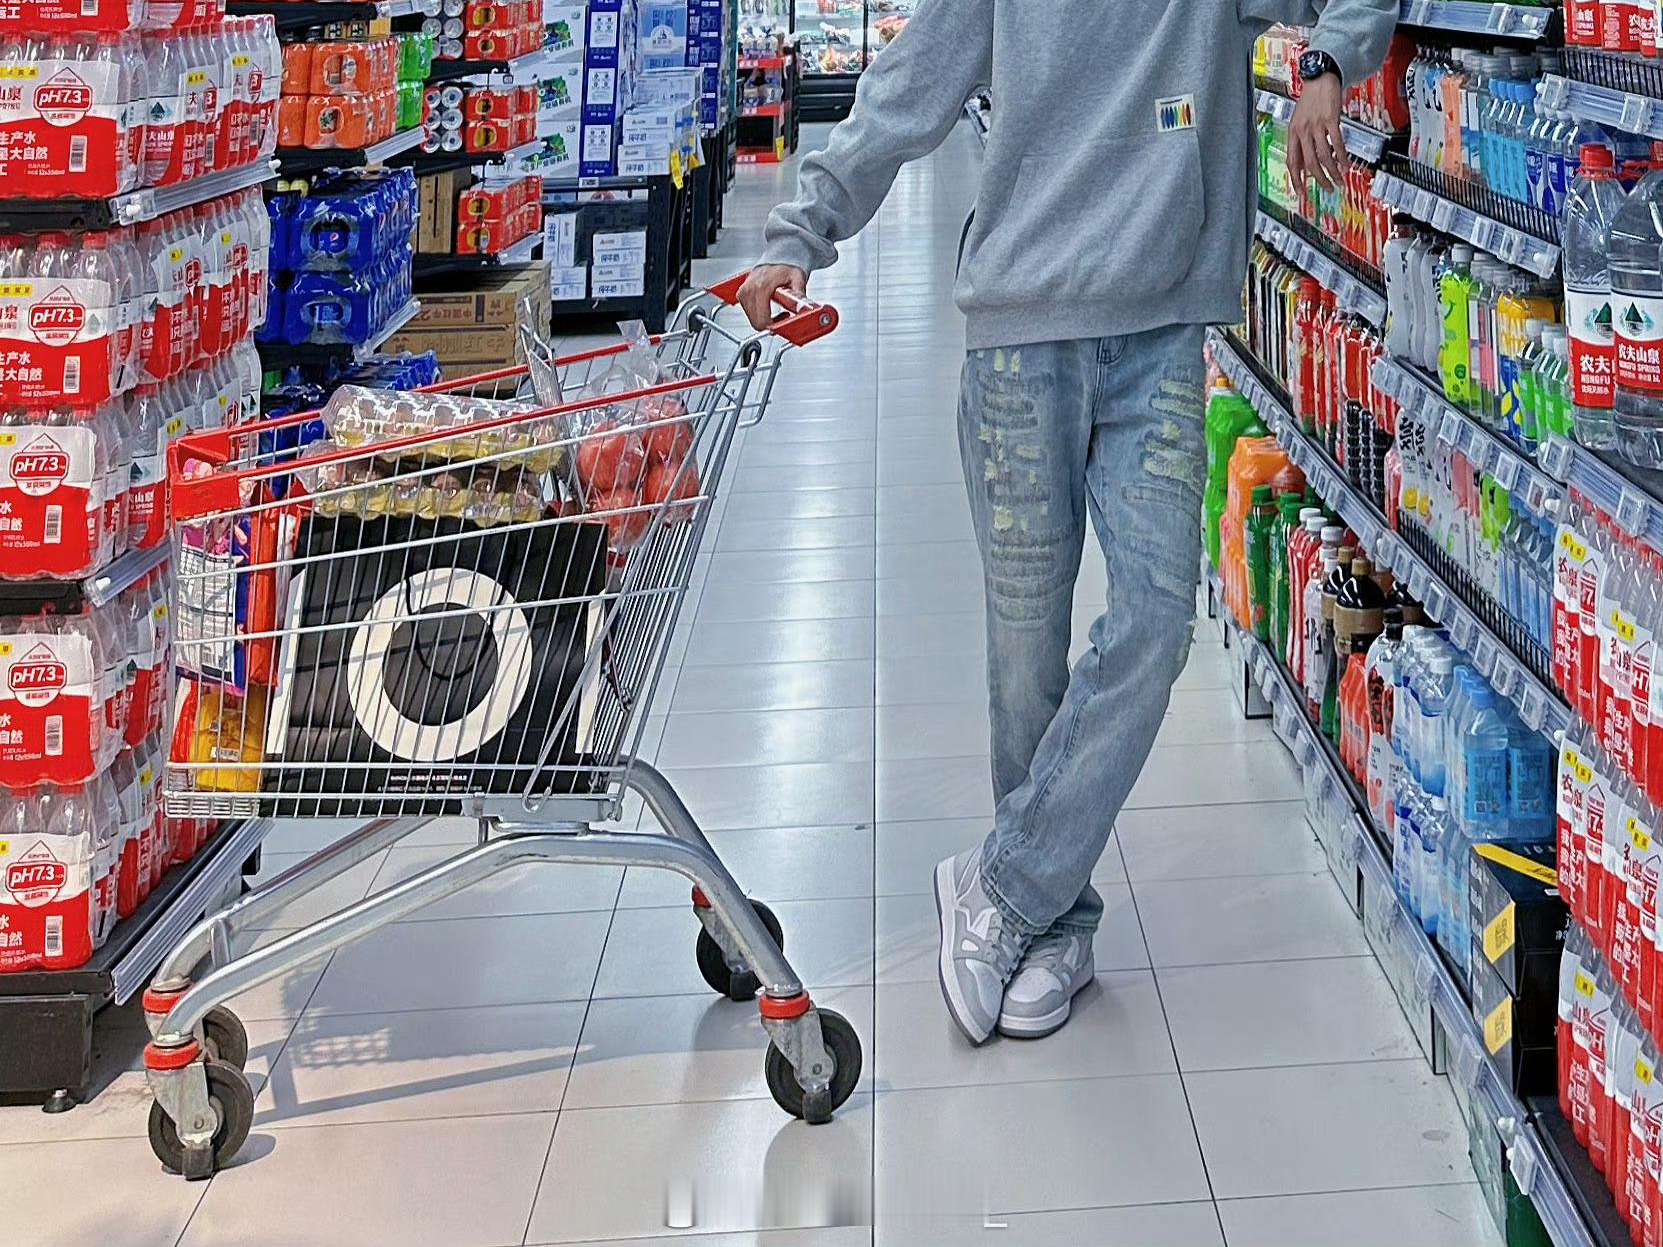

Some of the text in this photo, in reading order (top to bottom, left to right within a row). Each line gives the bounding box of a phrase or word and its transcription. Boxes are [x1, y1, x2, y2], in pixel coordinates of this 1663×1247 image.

[39, 89, 83, 106] pH7.3
[33, 308, 75, 327] pH7.3
[1619, 343, 1660, 364] 农夫山泉
[14, 456, 59, 475] pH7.3
[12, 666, 57, 687] pH7.3
[10, 866, 55, 887] pH7.3
